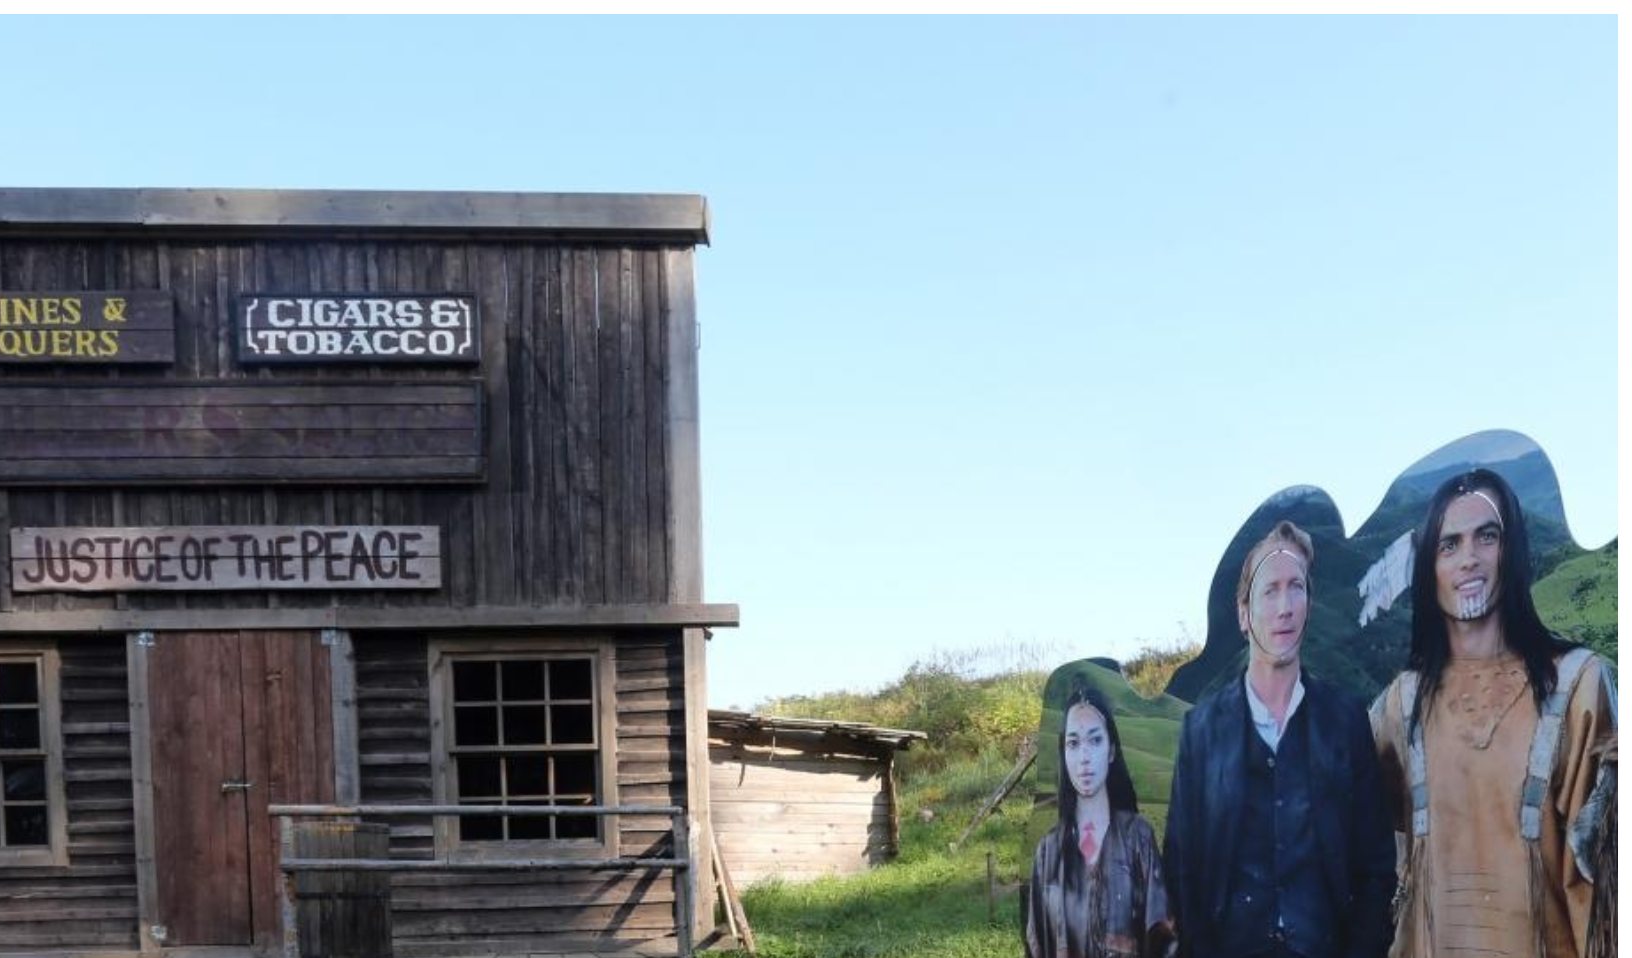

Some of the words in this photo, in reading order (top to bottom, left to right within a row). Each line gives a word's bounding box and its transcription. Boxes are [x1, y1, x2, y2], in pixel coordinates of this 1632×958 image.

[102, 298, 128, 322] &
[268, 299, 424, 327] CIGARS
[430, 299, 461, 327] &
[257, 330, 456, 355] TOBACCO
[22, 535, 178, 584] JUSTICE
[179, 537, 223, 582] OF
[226, 534, 297, 582] THE
[300, 530, 424, 583] PEACE
